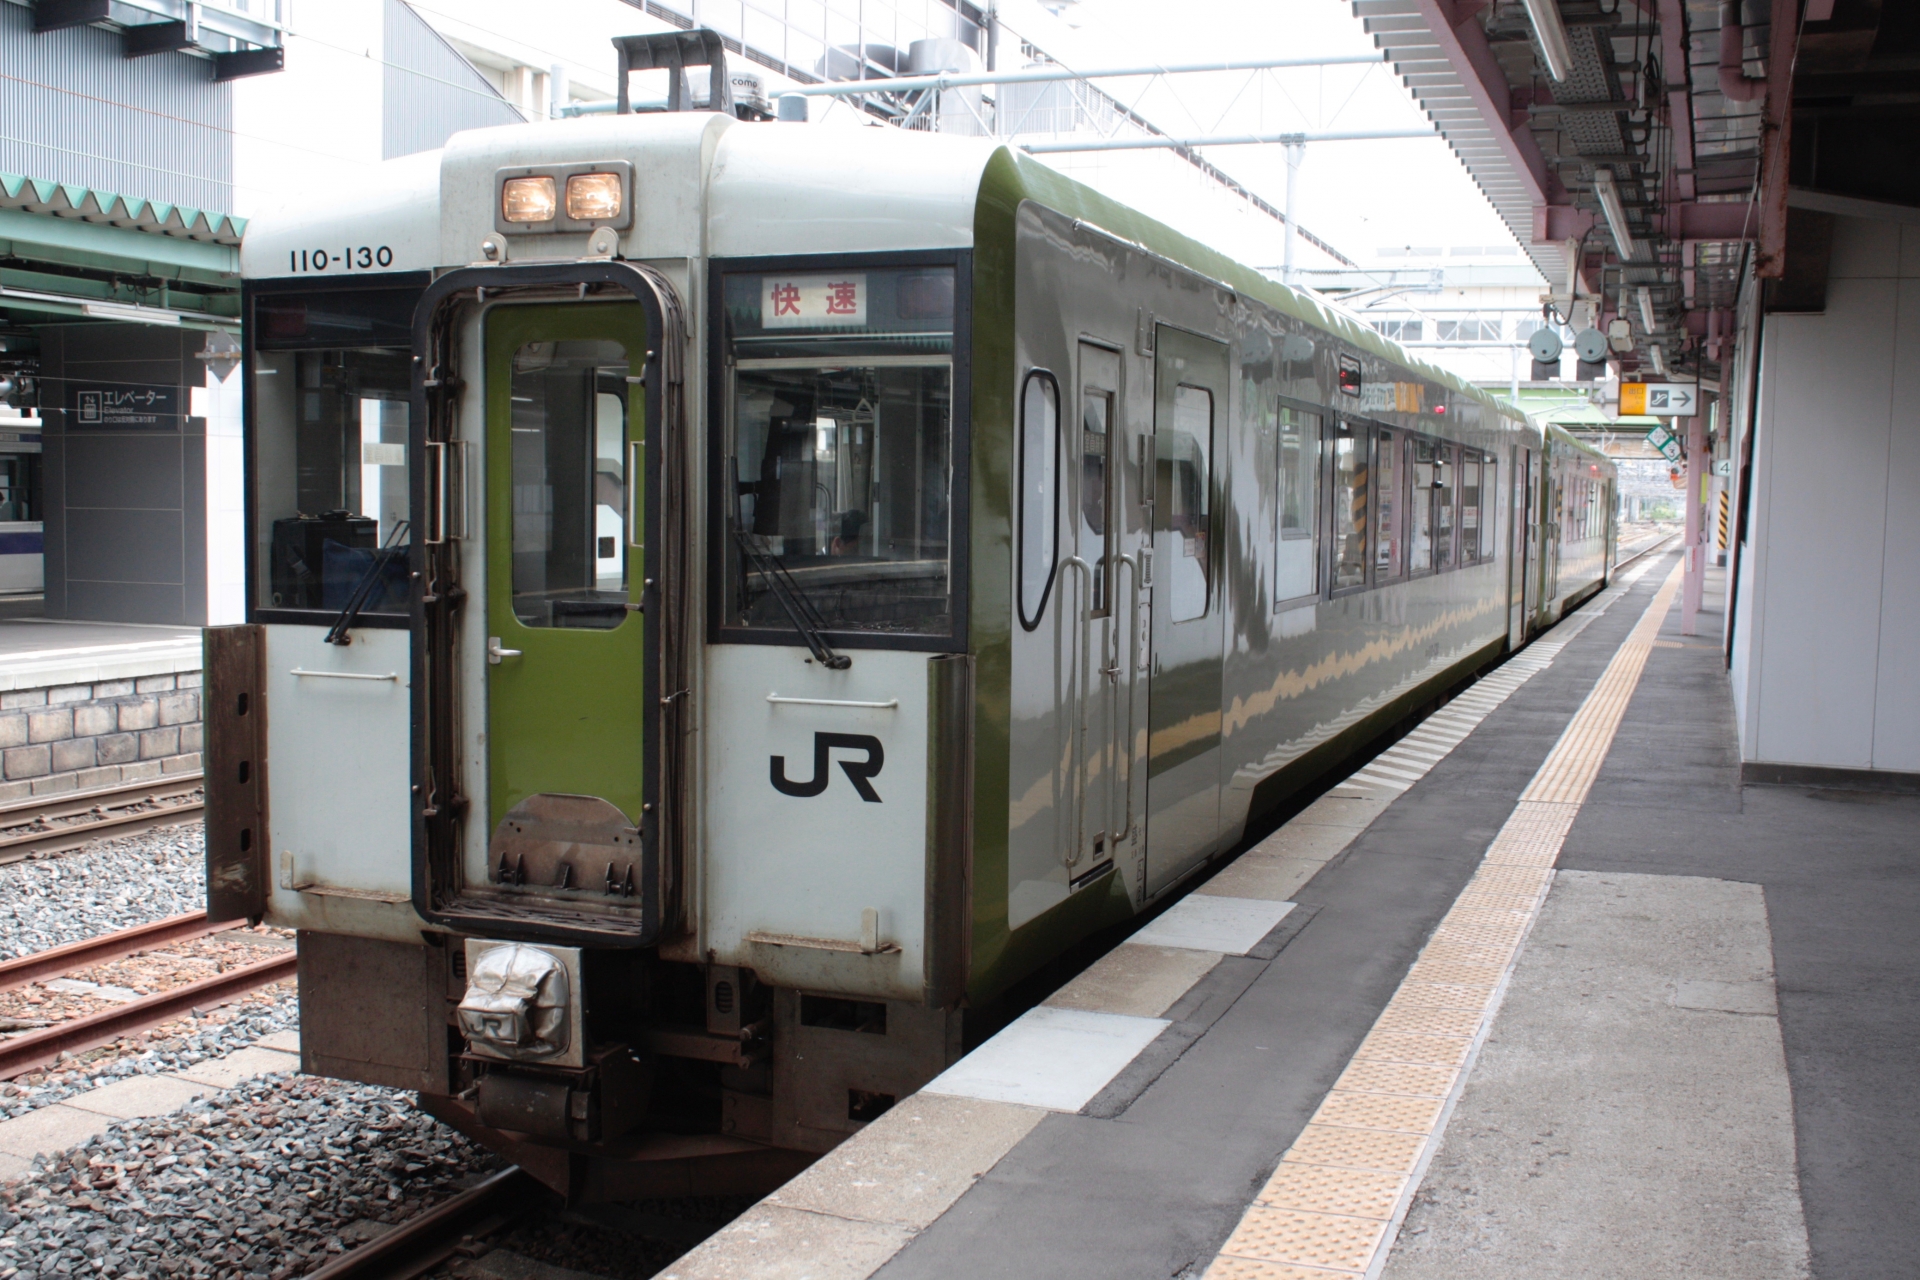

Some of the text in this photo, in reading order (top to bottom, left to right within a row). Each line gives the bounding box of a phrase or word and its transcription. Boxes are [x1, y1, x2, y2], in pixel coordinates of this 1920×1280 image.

[291, 245, 393, 273] 110-130
[770, 280, 857, 317] 快速
[103, 390, 167, 405] エレベーター
[1628, 387, 1643, 395] 出口
[103, 406, 134, 414] Elevator
[1668, 448, 1675, 458] 3
[1720, 462, 1730, 474] 4
[770, 731, 885, 804] JR
[470, 1016, 502, 1037] JR
